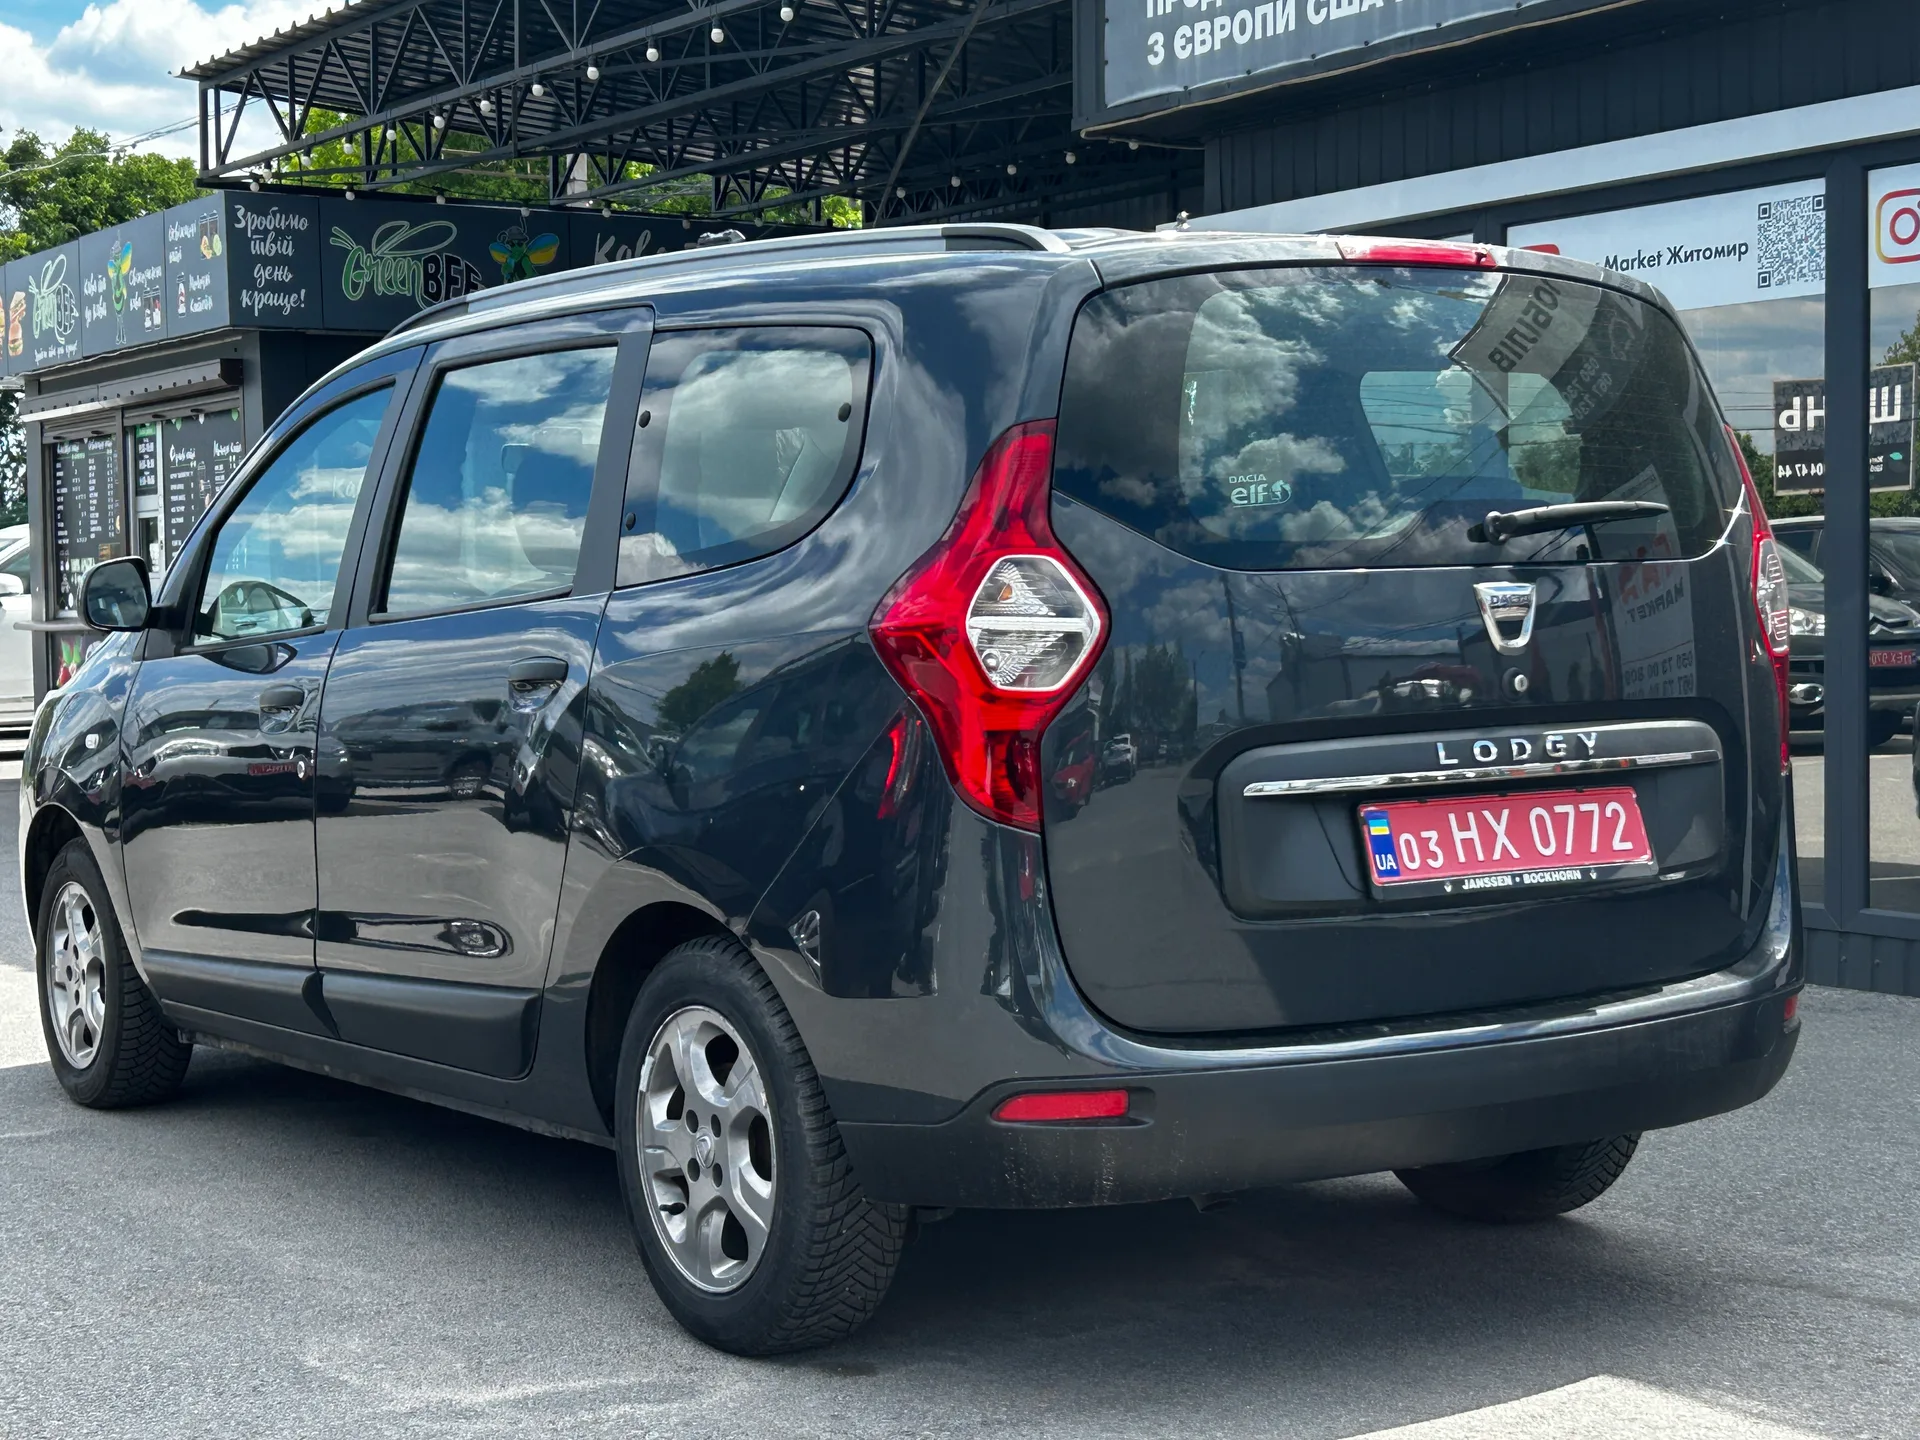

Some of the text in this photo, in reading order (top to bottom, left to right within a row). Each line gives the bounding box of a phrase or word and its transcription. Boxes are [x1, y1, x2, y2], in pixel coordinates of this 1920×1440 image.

[1146, 31, 1165, 66] З
[1173, 0, 1296, 60] ЄВРОПИ
[233, 204, 309, 238] Зробимо
[250, 230, 295, 257] твій
[1603, 241, 1749, 272] Market Житомир
[253, 263, 294, 288] день
[239, 288, 306, 317] краще!
[1228, 473, 1267, 484] DACIA
[1230, 483, 1269, 505] elf
[1436, 732, 1597, 765] LODGY
[1399, 801, 1634, 870] 03 HX 0772
[1375, 854, 1398, 870] UA
[1462, 869, 1582, 890] JANSSEN BOCKHORN
